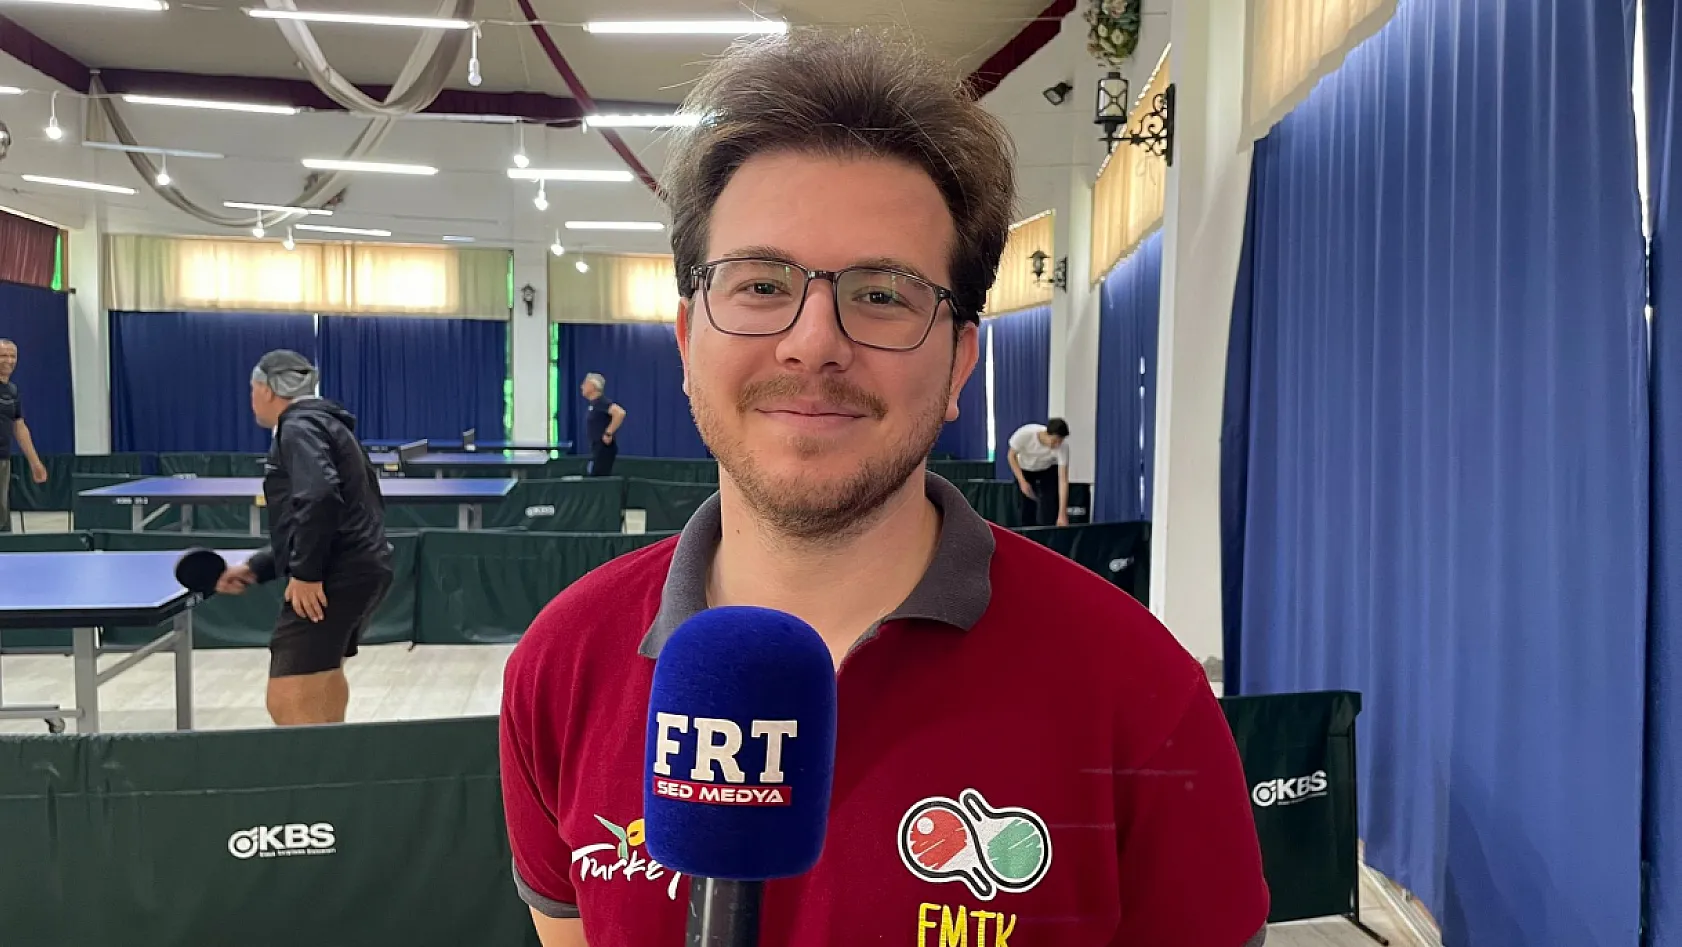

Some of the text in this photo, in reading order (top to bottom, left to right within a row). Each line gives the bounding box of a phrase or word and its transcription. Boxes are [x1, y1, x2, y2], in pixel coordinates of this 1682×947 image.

[653, 711, 798, 784] FRT
[657, 780, 784, 803] SED MEDYA
[1276, 769, 1328, 800] KBS
[259, 822, 336, 850] KBS
